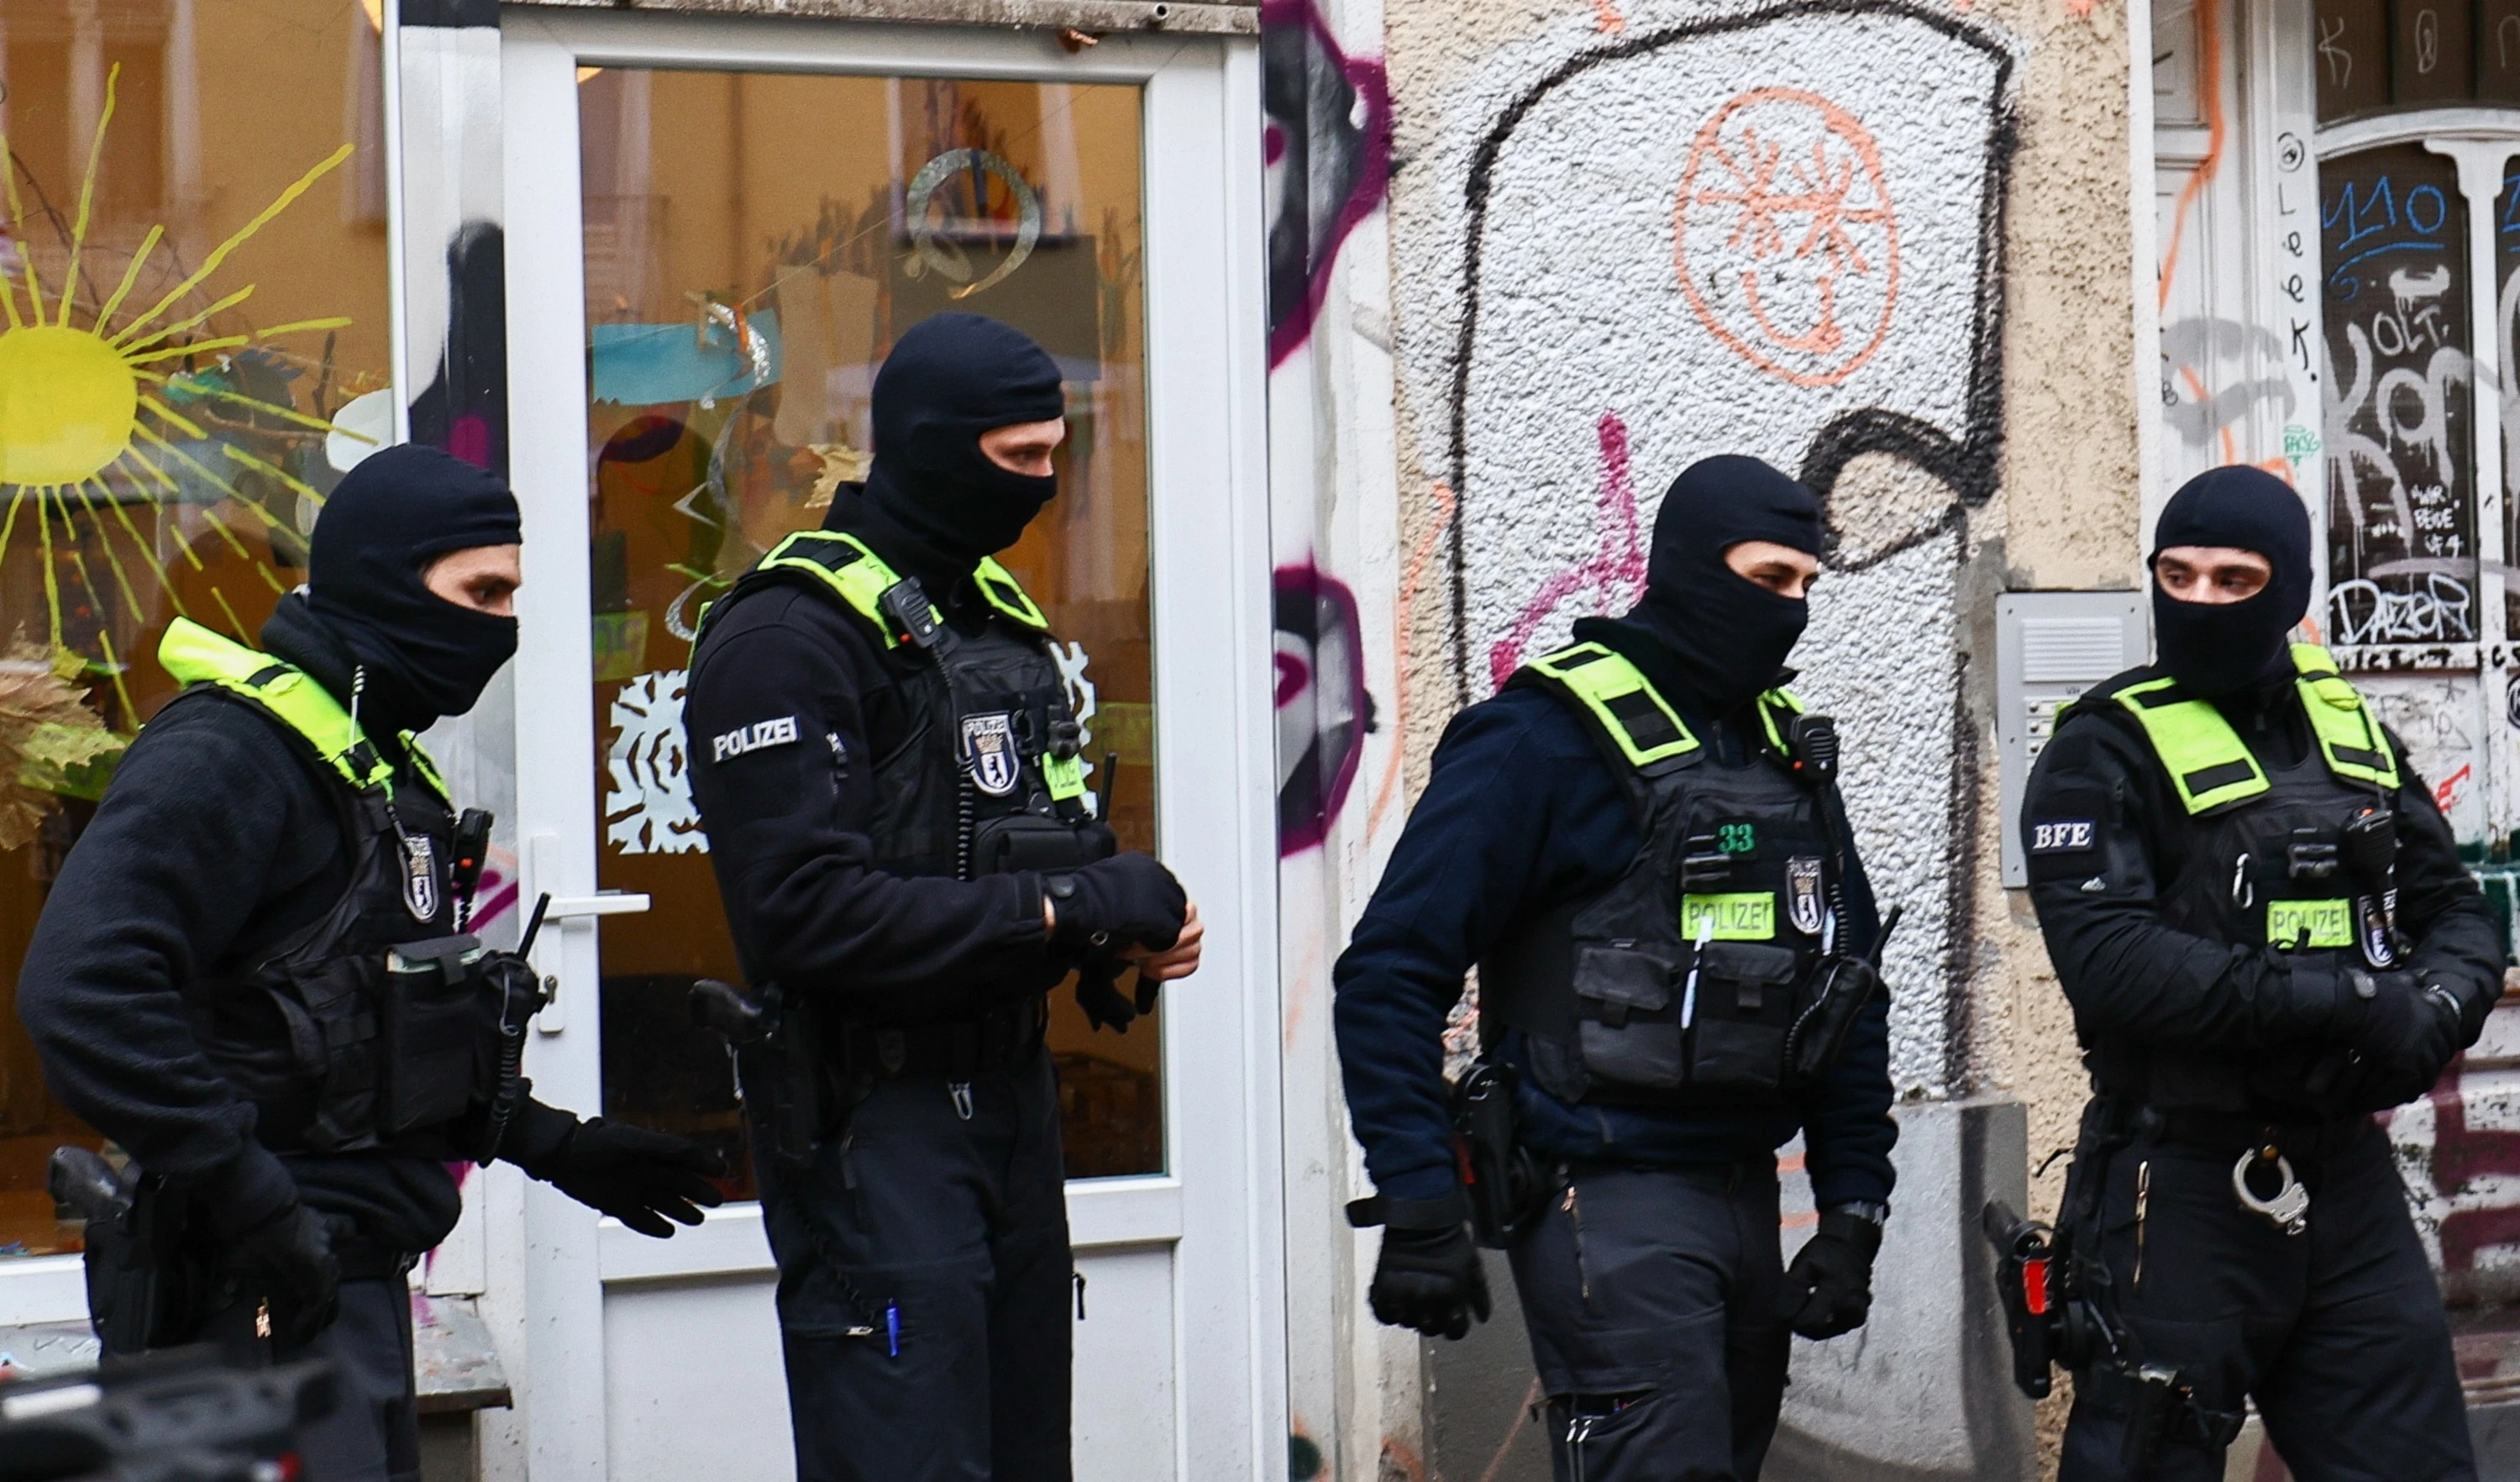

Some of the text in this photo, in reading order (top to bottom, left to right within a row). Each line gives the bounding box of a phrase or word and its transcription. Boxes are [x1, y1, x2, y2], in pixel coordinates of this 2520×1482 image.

[713, 717, 798, 762] POLIZEI
[1718, 823, 1756, 853] 33
[2033, 822, 2091, 850] BFE
